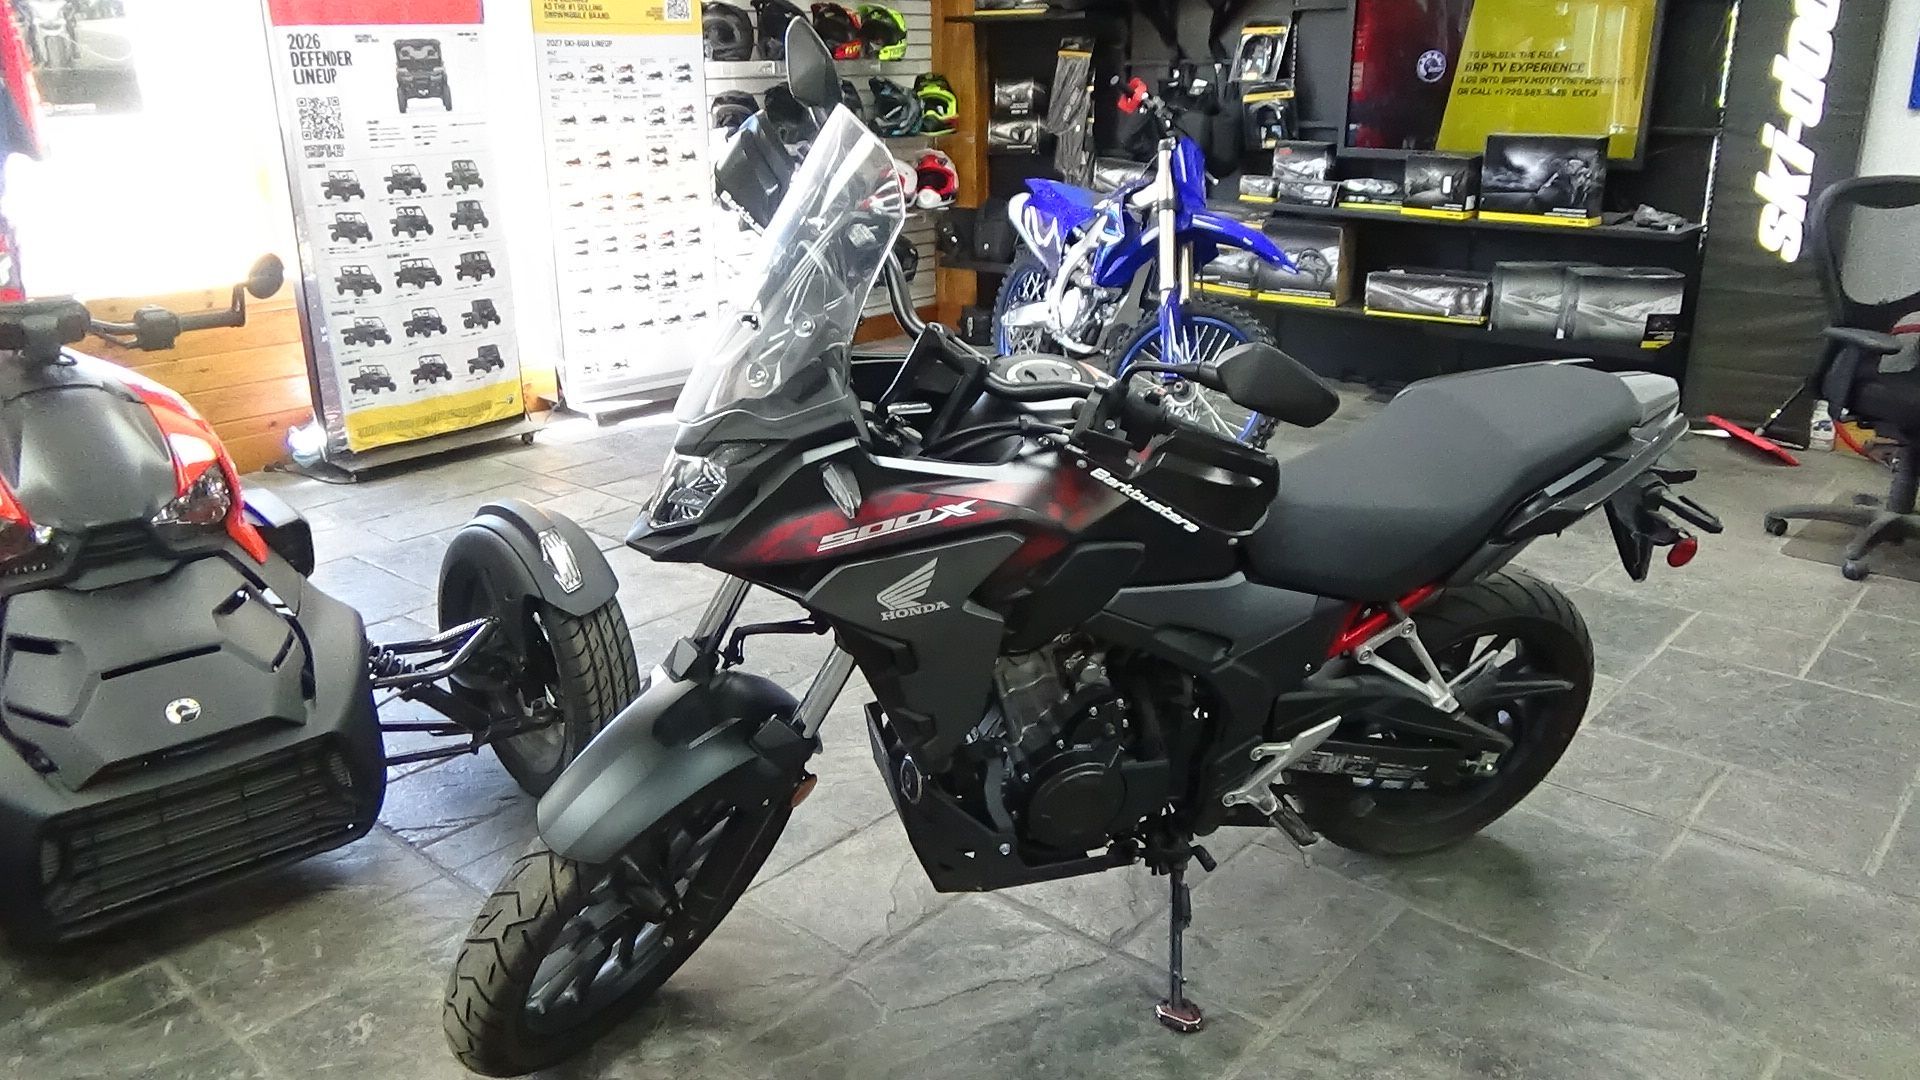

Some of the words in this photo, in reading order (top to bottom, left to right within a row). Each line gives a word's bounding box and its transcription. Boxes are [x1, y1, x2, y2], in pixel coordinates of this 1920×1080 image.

[287, 33, 320, 50] 2026
[291, 51, 352, 67] DEFENDER
[1492, 63, 1507, 73] TV
[1509, 63, 1587, 73] EXPERIENCE
[293, 69, 337, 84] LINEUP
[1470, 88, 1492, 96] CALL
[1090, 467, 1200, 533] Barkbusters
[816, 499, 979, 551] 500X
[880, 600, 951, 621] HONDA
